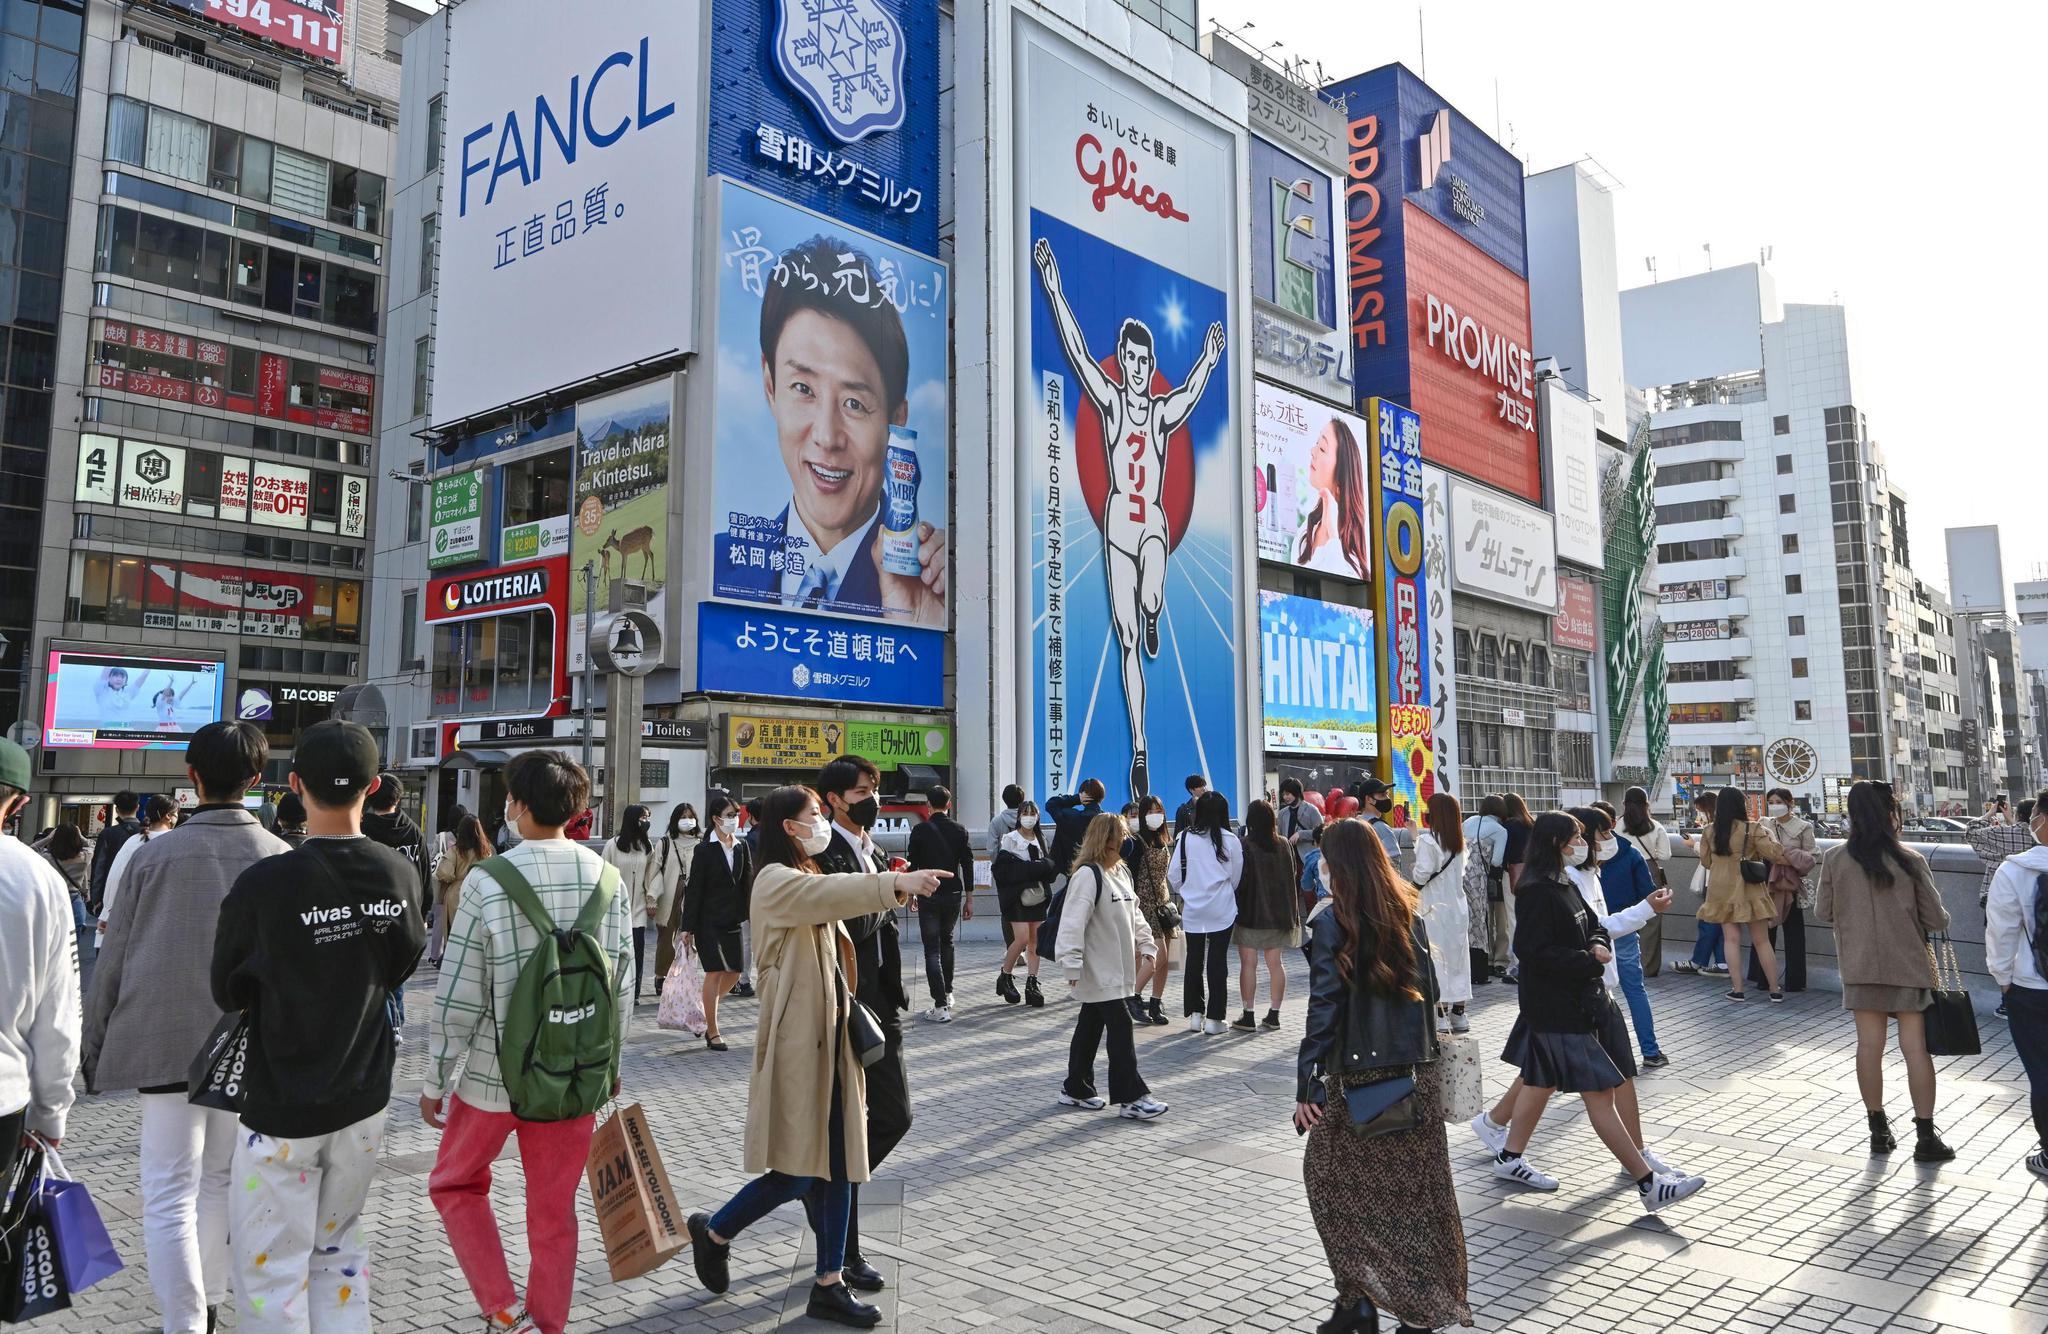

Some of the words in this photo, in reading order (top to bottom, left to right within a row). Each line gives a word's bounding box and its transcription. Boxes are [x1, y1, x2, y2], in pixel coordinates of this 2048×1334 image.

[1250, 65, 1318, 119] 夢ある住まい
[460, 36, 675, 217] FANCL
[1087, 102, 1177, 167] おいしさと健康
[756, 122, 922, 213] 雪印メグミルク
[1075, 133, 1190, 222] Glico
[493, 182, 625, 270] 正直品質。
[1426, 293, 1533, 399] PROMISE
[102, 368, 123, 387] 5F
[1496, 390, 1535, 433] プロミス
[581, 441, 619, 467] Travel
[622, 447, 631, 457] to
[632, 434, 664, 454] Nara
[1379, 406, 1402, 493] 礼金
[1402, 415, 1422, 500] 敷金
[86, 448, 107, 488] 4F
[580, 481, 591, 492] on
[592, 463, 652, 489] Kintetsu.
[1125, 430, 1147, 524] グリコ
[123, 483, 181, 506] 相席屋
[584, 510, 597, 524] 35
[729, 511, 785, 532] 雪印メグミルク
[729, 526, 810, 549] 健康推進アンバサダー
[729, 543, 806, 576] 松岡修造
[1480, 537, 1534, 582] サムティ
[245, 582, 298, 608] 風月
[464, 572, 541, 604] LOTTERIA
[145, 614, 174, 628] 営業時間
[736, 621, 918, 665] ようこそ道頓堀へ
[812, 671, 871, 688] 雪印メグミルク
[508, 723, 534, 735] Toilets
[656, 722, 692, 737] Toilets
[760, 724, 819, 739] 店舗情報館
[1390, 705, 1432, 738] ひまわり
[880, 727, 921, 756] ピタットハウス
[596, 1149, 633, 1200] JAM
[626, 1117, 643, 1147] HOPE
[638, 1150, 651, 1169] SEE
[645, 1168, 661, 1195] YOU
[654, 1194, 678, 1237] SOON!!
[35, 1224, 58, 1298] COCOLO
